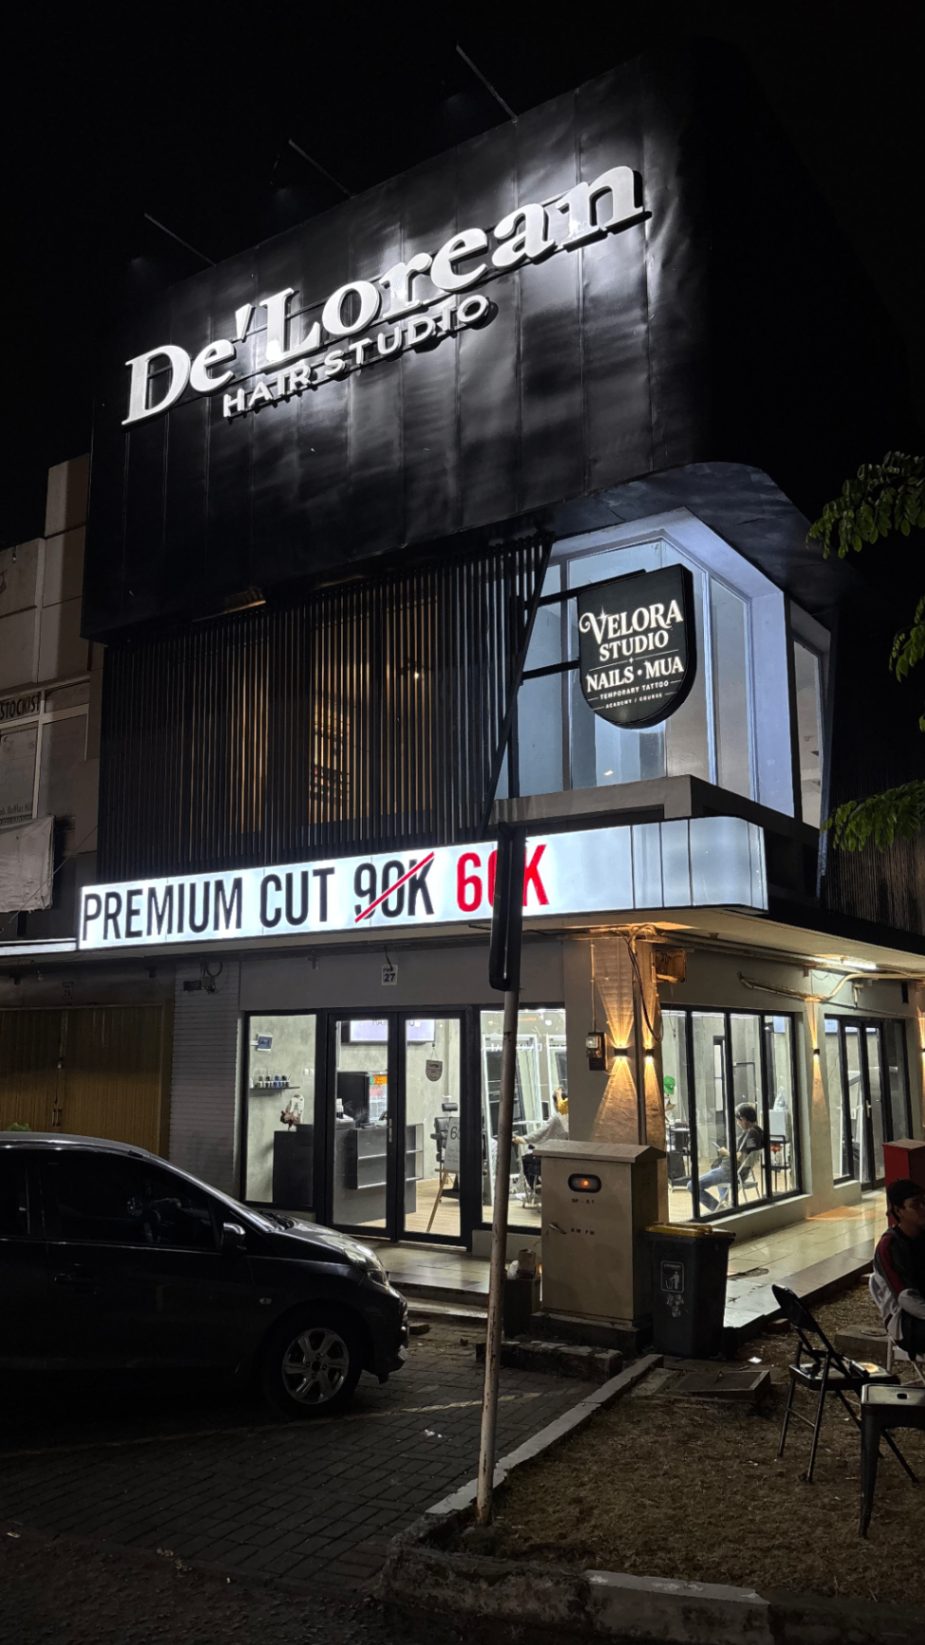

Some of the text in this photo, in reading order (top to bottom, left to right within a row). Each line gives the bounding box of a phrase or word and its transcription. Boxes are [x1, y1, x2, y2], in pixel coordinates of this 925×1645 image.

[121, 165, 645, 427] De'Lorean
[222, 294, 491, 418] HAIR STUDIO
[579, 600, 684, 645] VELORA
[599, 629, 669, 662] STUDIO
[585, 655, 685, 694] NAILS MUA
[641, 680, 669, 691] TATTOO
[82, 876, 243, 942] PREMIUM
[259, 866, 336, 929] CUT
[353, 853, 435, 922] 90K
